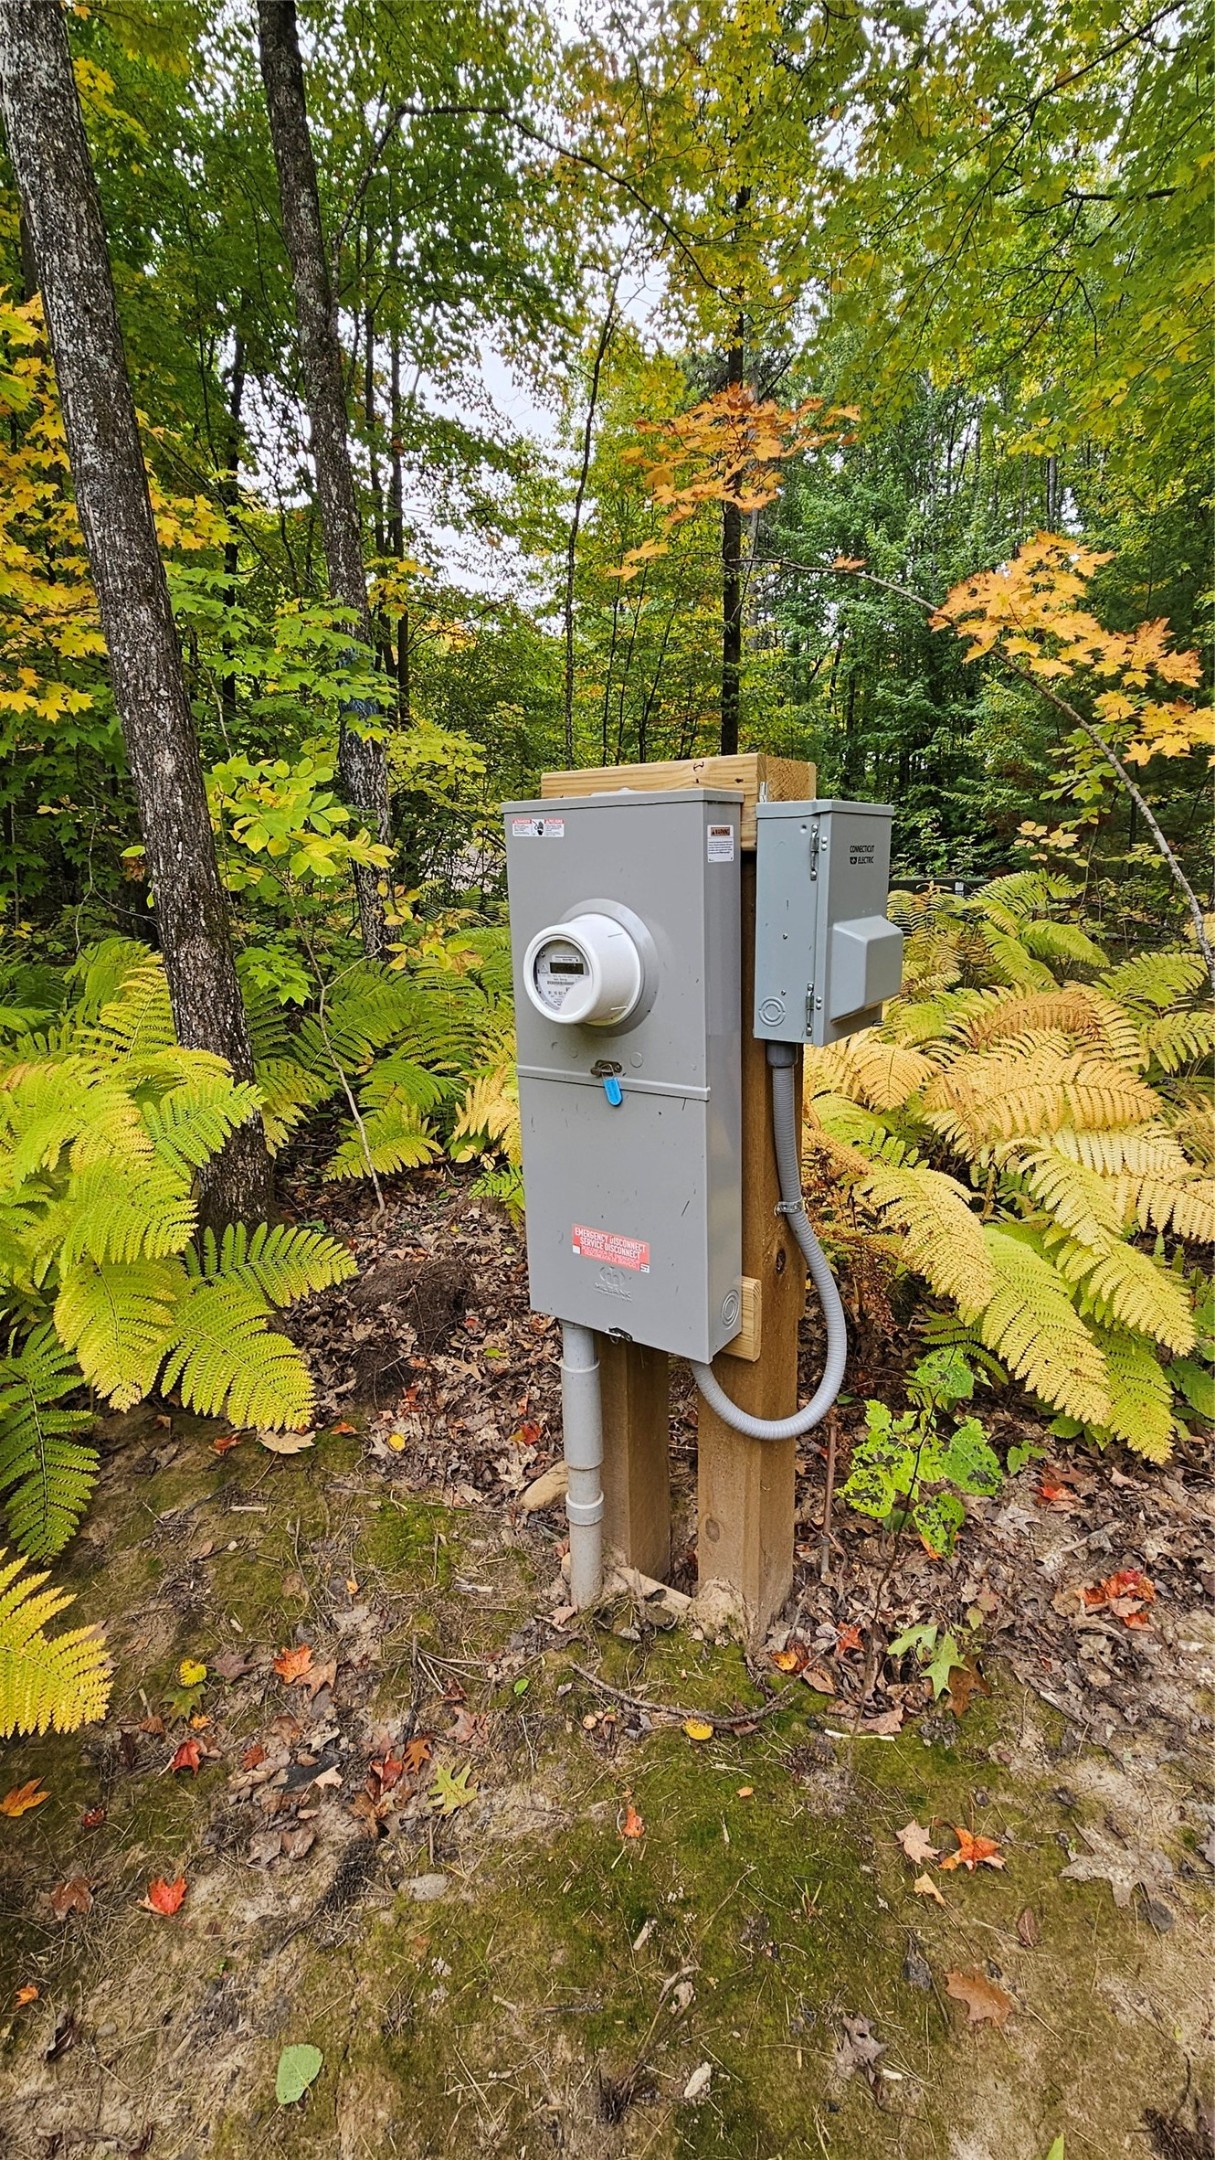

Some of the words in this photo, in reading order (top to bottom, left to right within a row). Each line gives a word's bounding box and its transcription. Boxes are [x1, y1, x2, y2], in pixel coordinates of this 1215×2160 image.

[849, 845, 875, 853] CONNECTICUT
[857, 856, 874, 864] ELECTRIC
[574, 1227, 608, 1244] EMERGENCY
[609, 1236, 646, 1253] DISCONNECT
[580, 1236, 604, 1250] SERVICE
[604, 1243, 640, 1259] DISCONNECT
